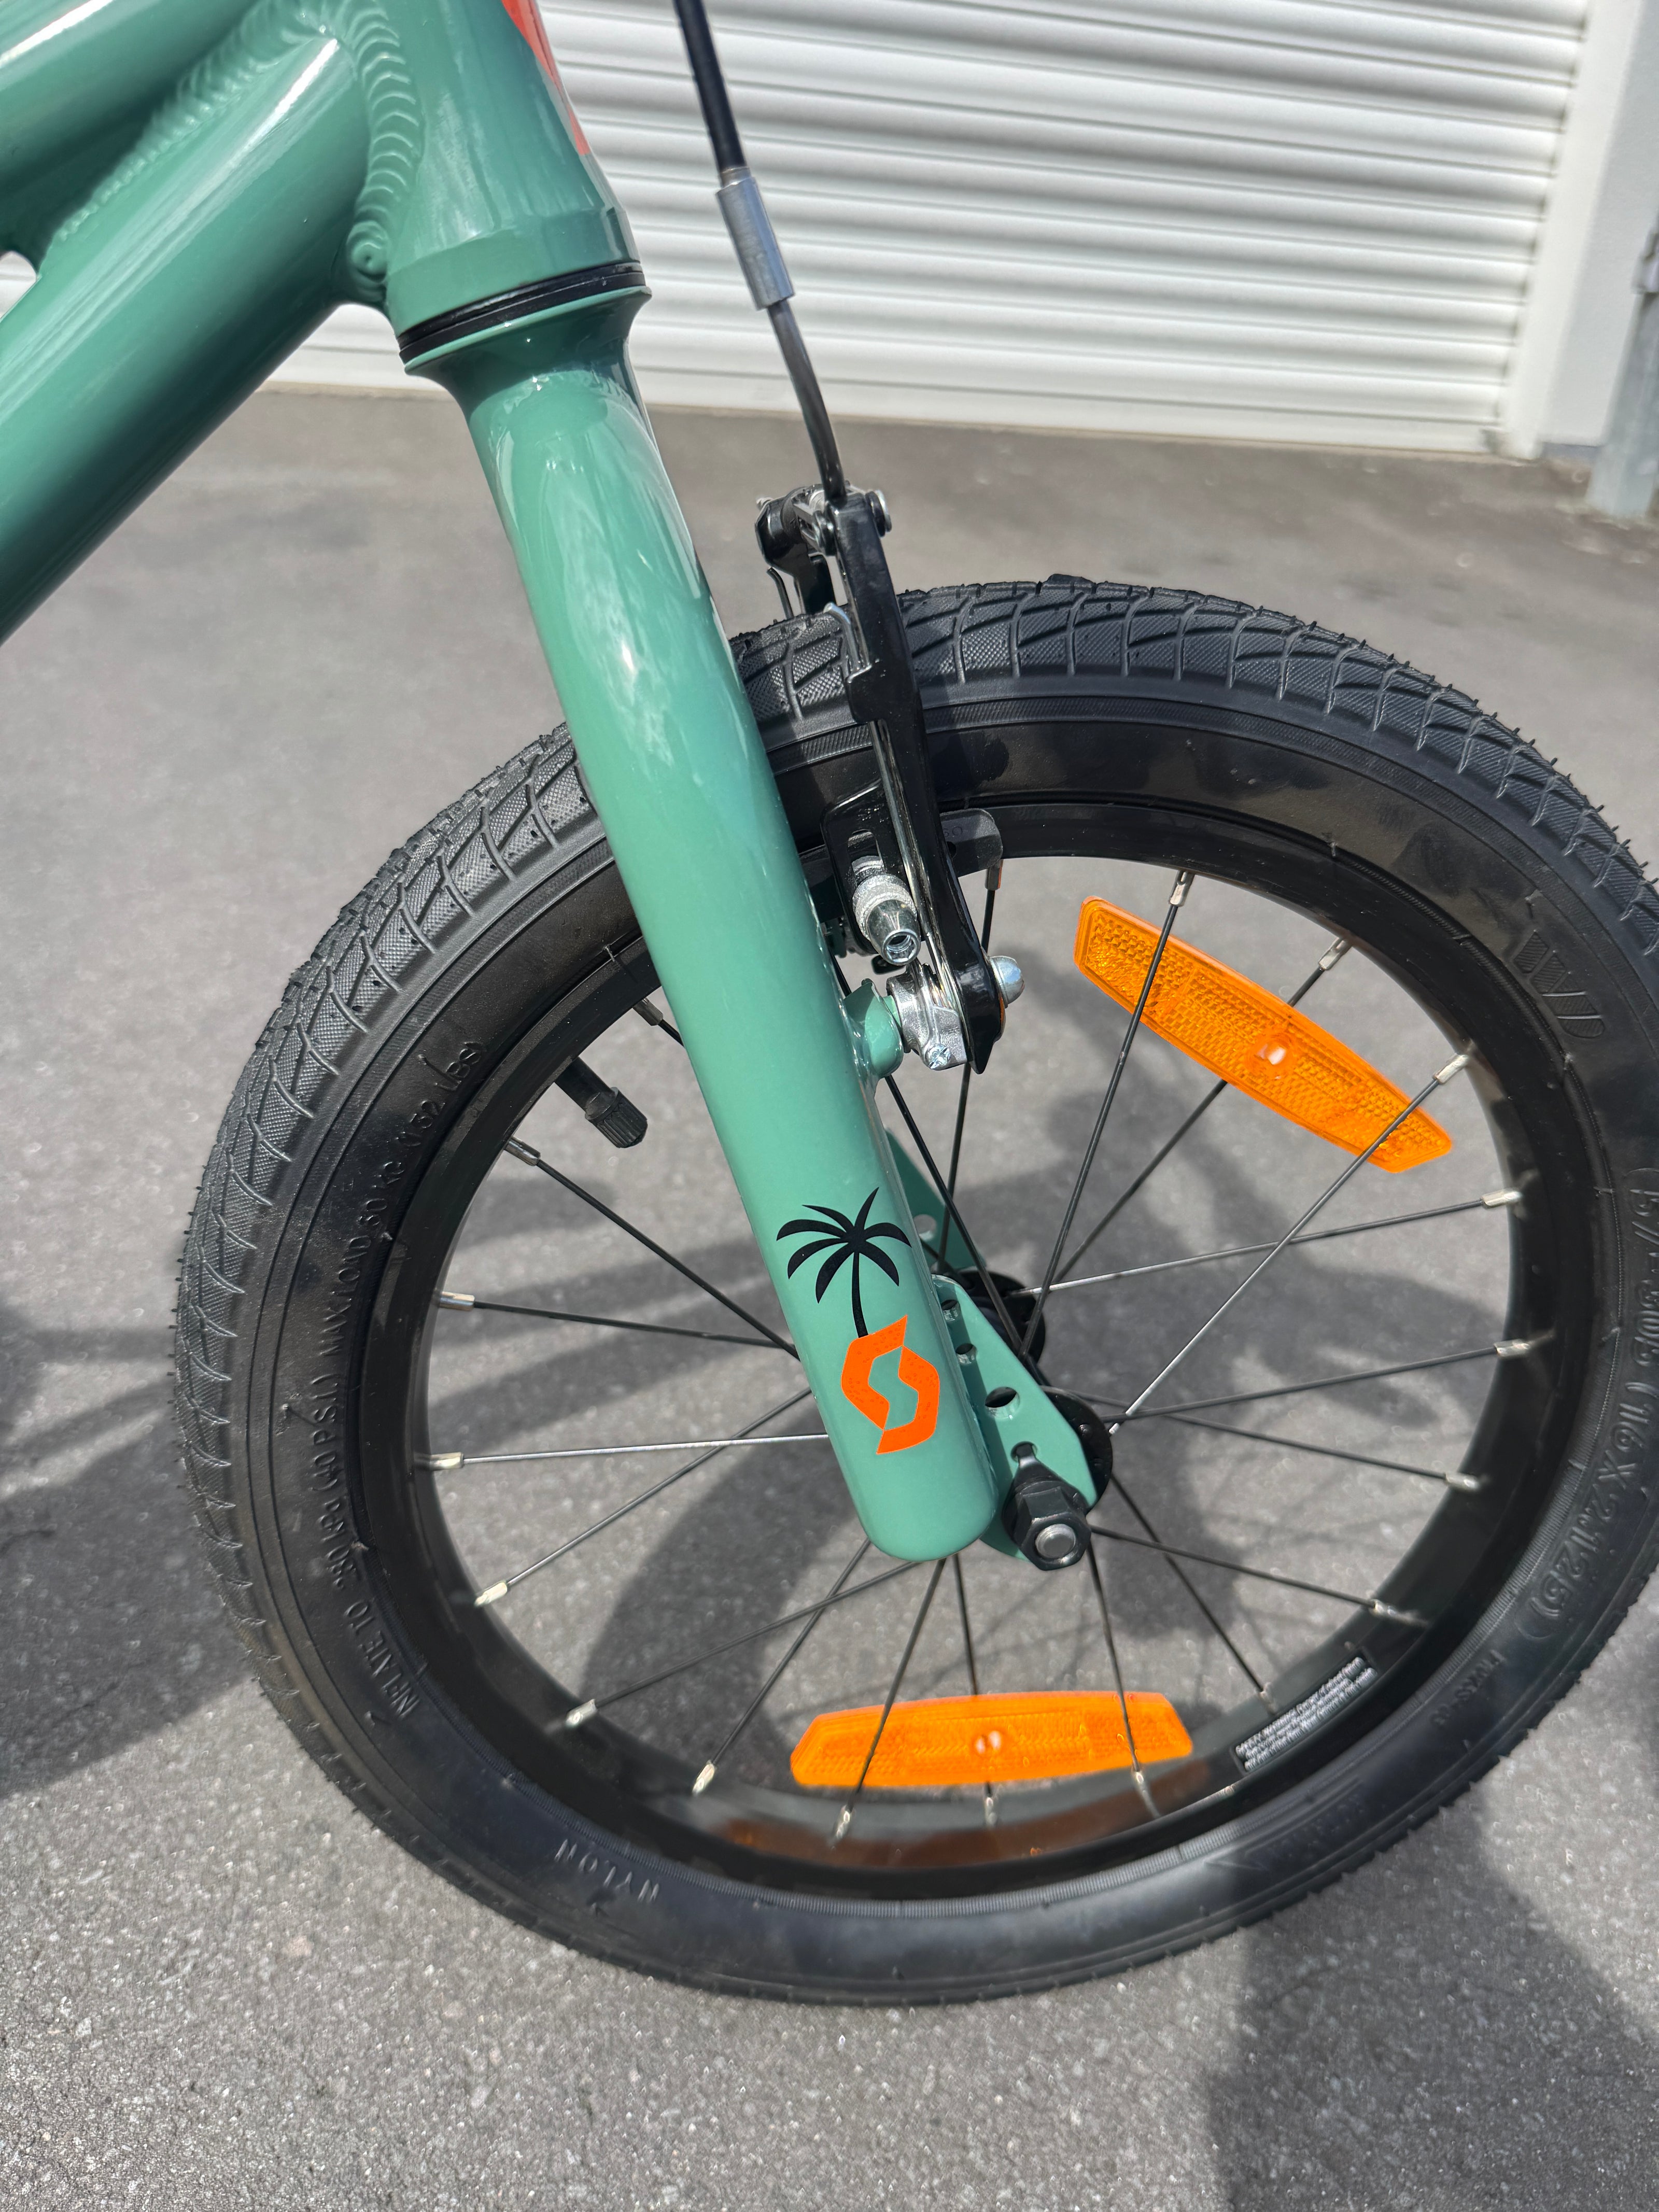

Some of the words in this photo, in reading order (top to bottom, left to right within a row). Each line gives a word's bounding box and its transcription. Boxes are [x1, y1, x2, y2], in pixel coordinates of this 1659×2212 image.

[341, 1598, 374, 1638] TO
[357, 1630, 420, 1721] INFLATE
[553, 1838, 660, 1905] NYLON
